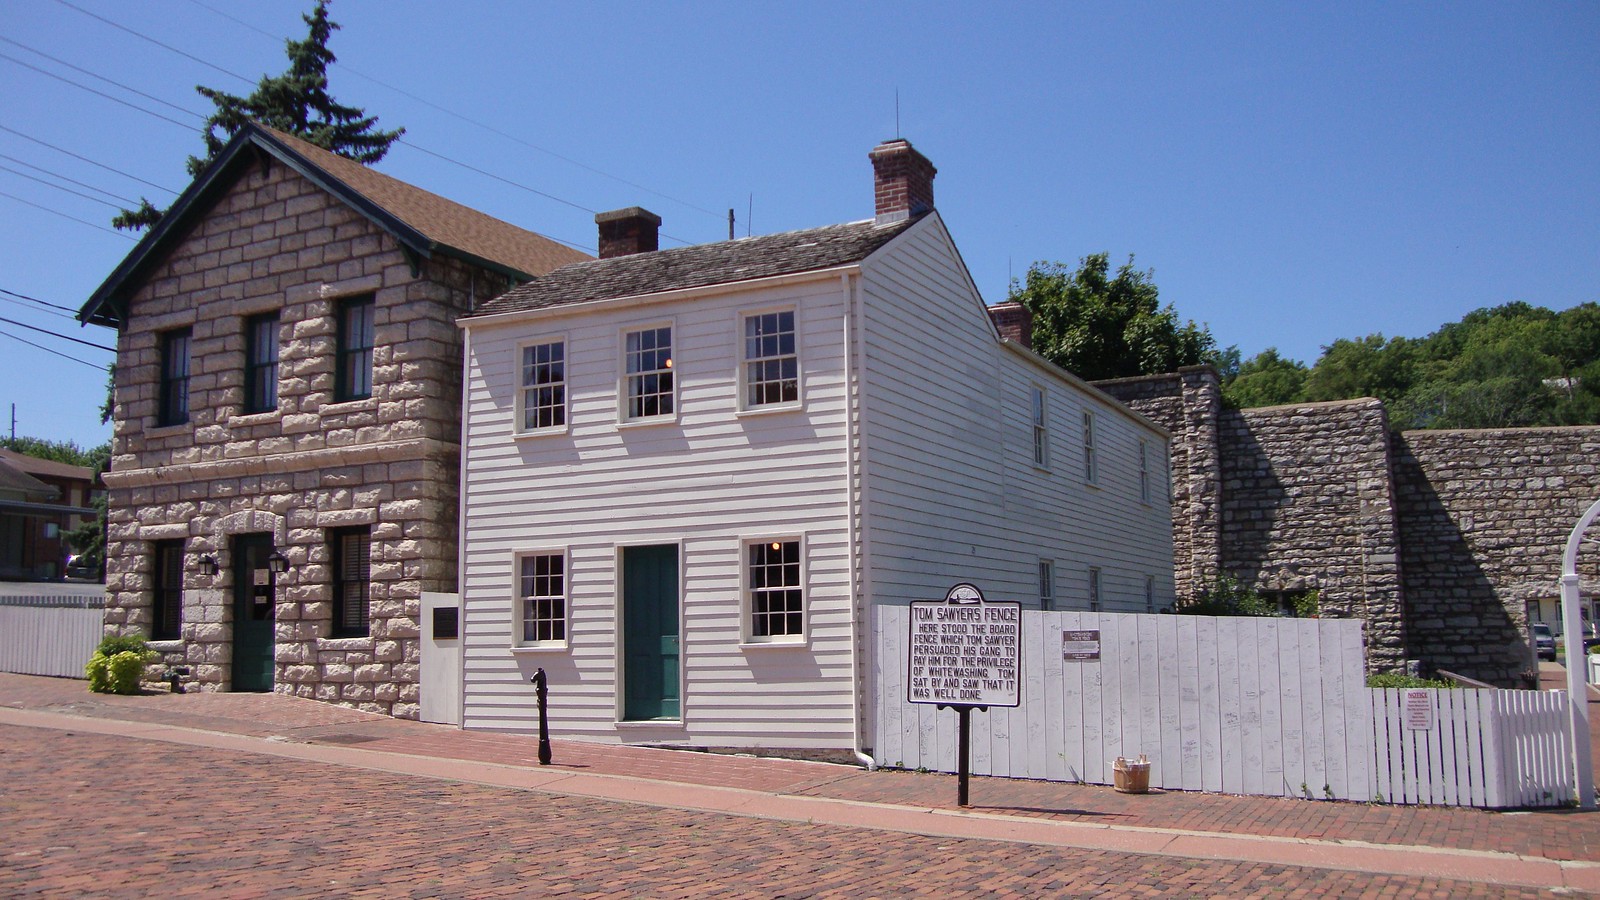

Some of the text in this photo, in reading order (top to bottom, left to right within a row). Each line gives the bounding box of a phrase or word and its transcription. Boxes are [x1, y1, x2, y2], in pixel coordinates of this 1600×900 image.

[913, 608, 933, 620] TOM
[984, 608, 1017, 621] FENCE
[919, 624, 1015, 634] HERE STOOD THE BOARD
[914, 635, 1015, 645] FENCE WHICH TOM SAWYER
[914, 646, 1016, 656] PERSUADED HIS GANG TO
[914, 656, 1014, 667] PAY HIM FOR THE PRIVILEGE
[914, 667, 924, 676] OF
[998, 669, 1014, 678] TOM
[913, 678, 1014, 690] SAT BY AND SAW THAT IT
[913, 689, 930, 698] WAS
[934, 689, 956, 699] WELL
